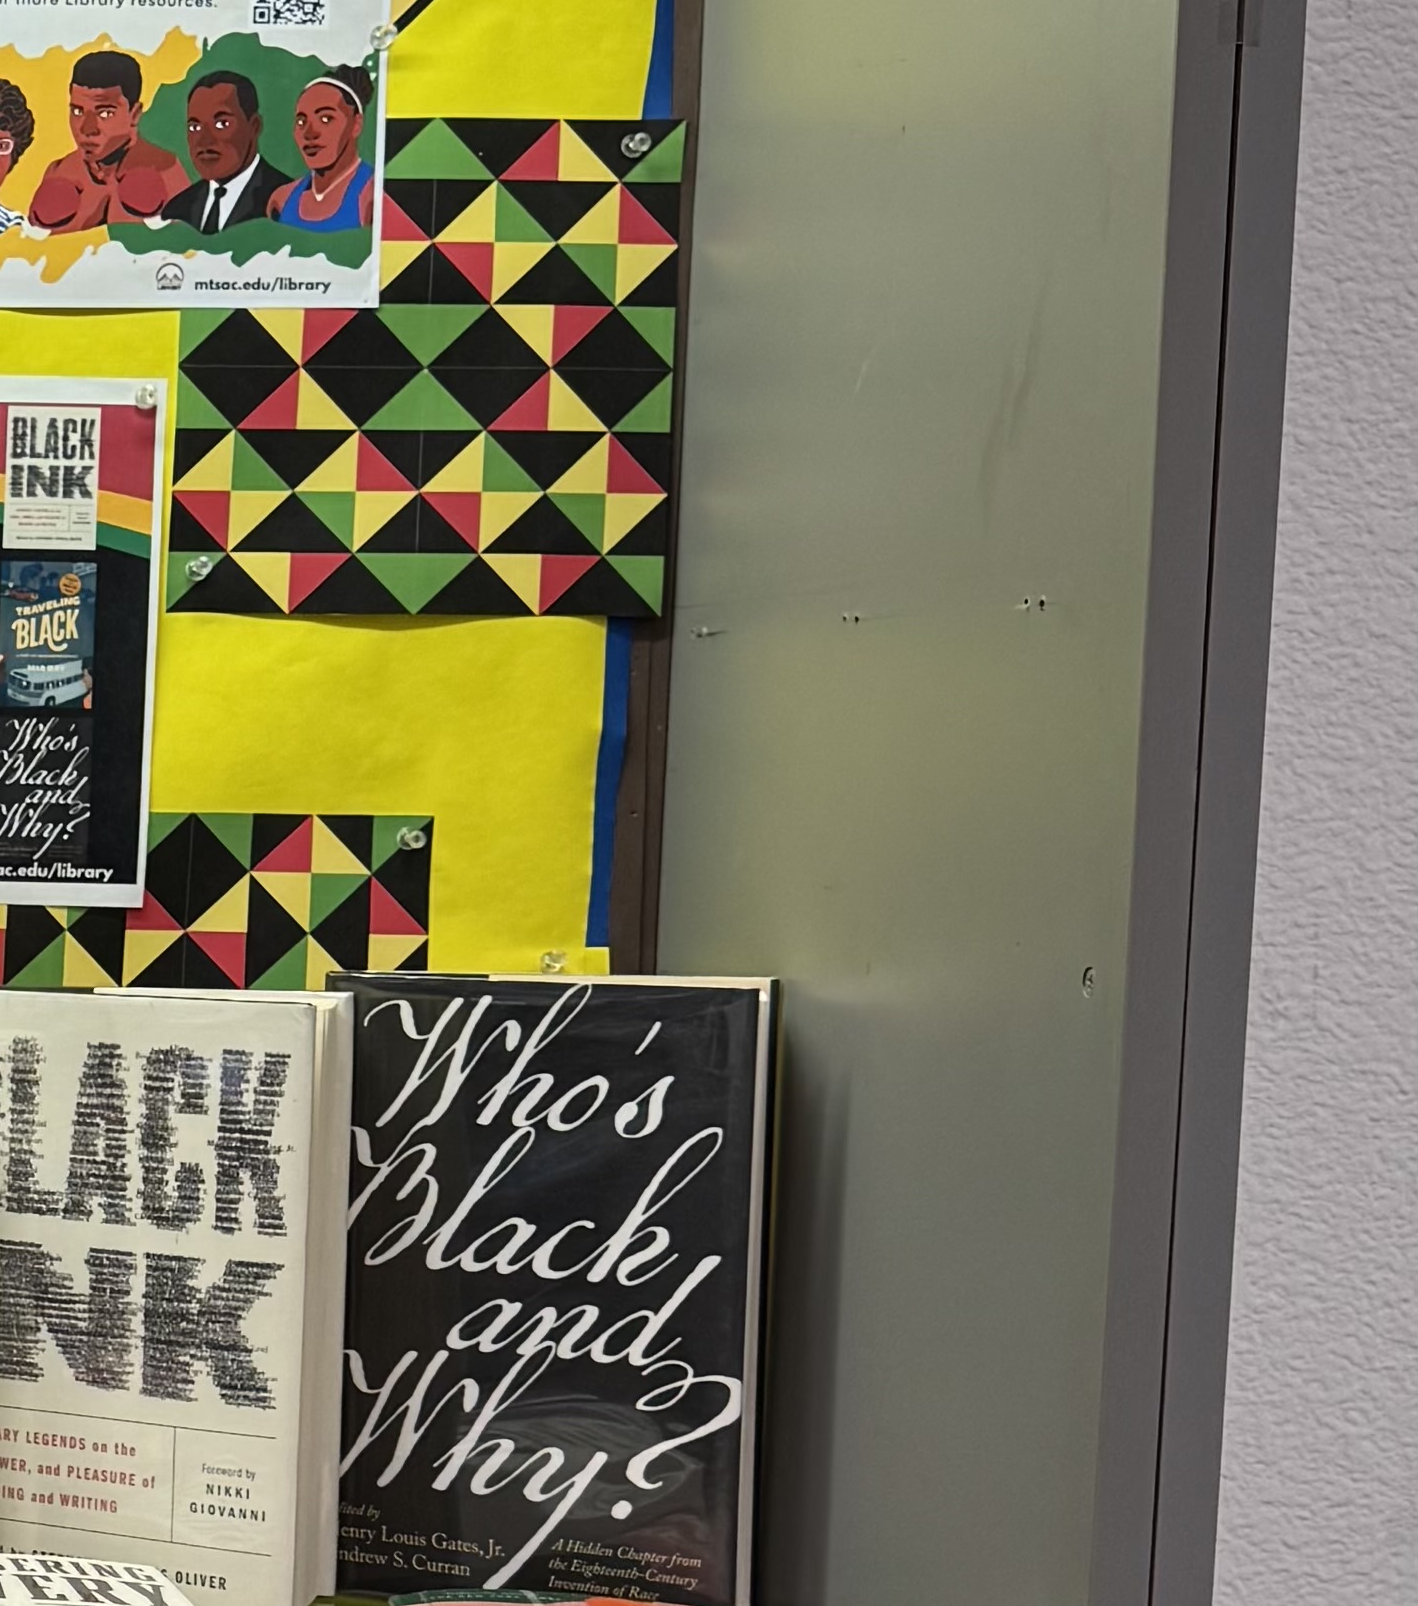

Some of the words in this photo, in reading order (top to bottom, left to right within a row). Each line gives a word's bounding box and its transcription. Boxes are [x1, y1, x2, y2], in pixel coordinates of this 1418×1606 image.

[195, 277, 331, 294] mtsac.edu/library
[364, 983, 675, 1138] Who's
[347, 1125, 724, 1286] Black
[446, 1255, 721, 1367] and
[190, 1502, 265, 1522] GIOVANNI
[206, 1483, 250, 1500] NIKKI
[338, 1340, 742, 1591] Why?
